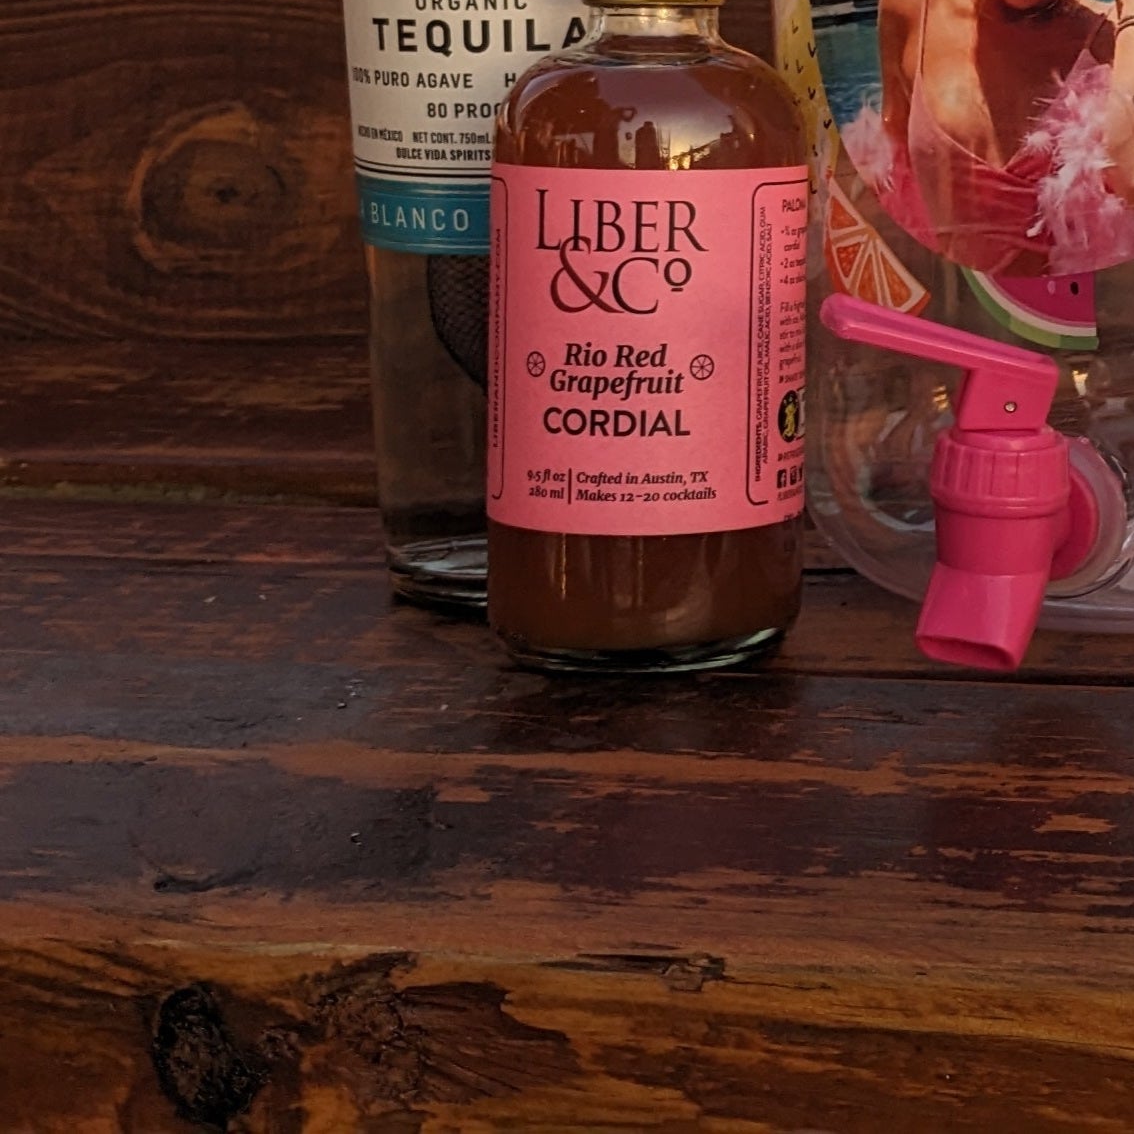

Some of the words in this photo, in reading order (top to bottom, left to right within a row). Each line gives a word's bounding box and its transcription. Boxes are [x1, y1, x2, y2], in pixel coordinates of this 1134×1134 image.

[372, 17, 586, 57] TEQUILA
[374, 70, 410, 88] PURO
[416, 73, 474, 89] AGAVE
[427, 102, 448, 118] 80
[413, 131, 428, 143] NET
[430, 132, 458, 144] CONT.
[459, 132, 491, 145] 750mL
[396, 147, 422, 160] DULCE
[424, 148, 448, 161] VIDA
[450, 149, 491, 162] SPIRITS
[371, 201, 469, 232] BLANCO
[535, 189, 709, 252] LIBER
[755, 368, 763, 421] GRAPEFRUIT
[759, 206, 767, 228] GUM
[564, 343, 607, 366] Rio
[614, 344, 667, 367] Red
[550, 370, 684, 400] Grapefruit
[762, 377, 770, 429] GRAPEFRUIT
[543, 407, 691, 437] CORDIAL
[527, 469, 541, 482] 9.5
[552, 473, 565, 482] oz
[576, 471, 622, 487] Crafted
[625, 472, 638, 484] in
[641, 472, 687, 487] Austin,
[690, 471, 709, 483] TX
[529, 486, 548, 498] 280
[550, 486, 565, 499] ml
[576, 488, 617, 502] Makes
[663, 487, 717, 501] cocktails
